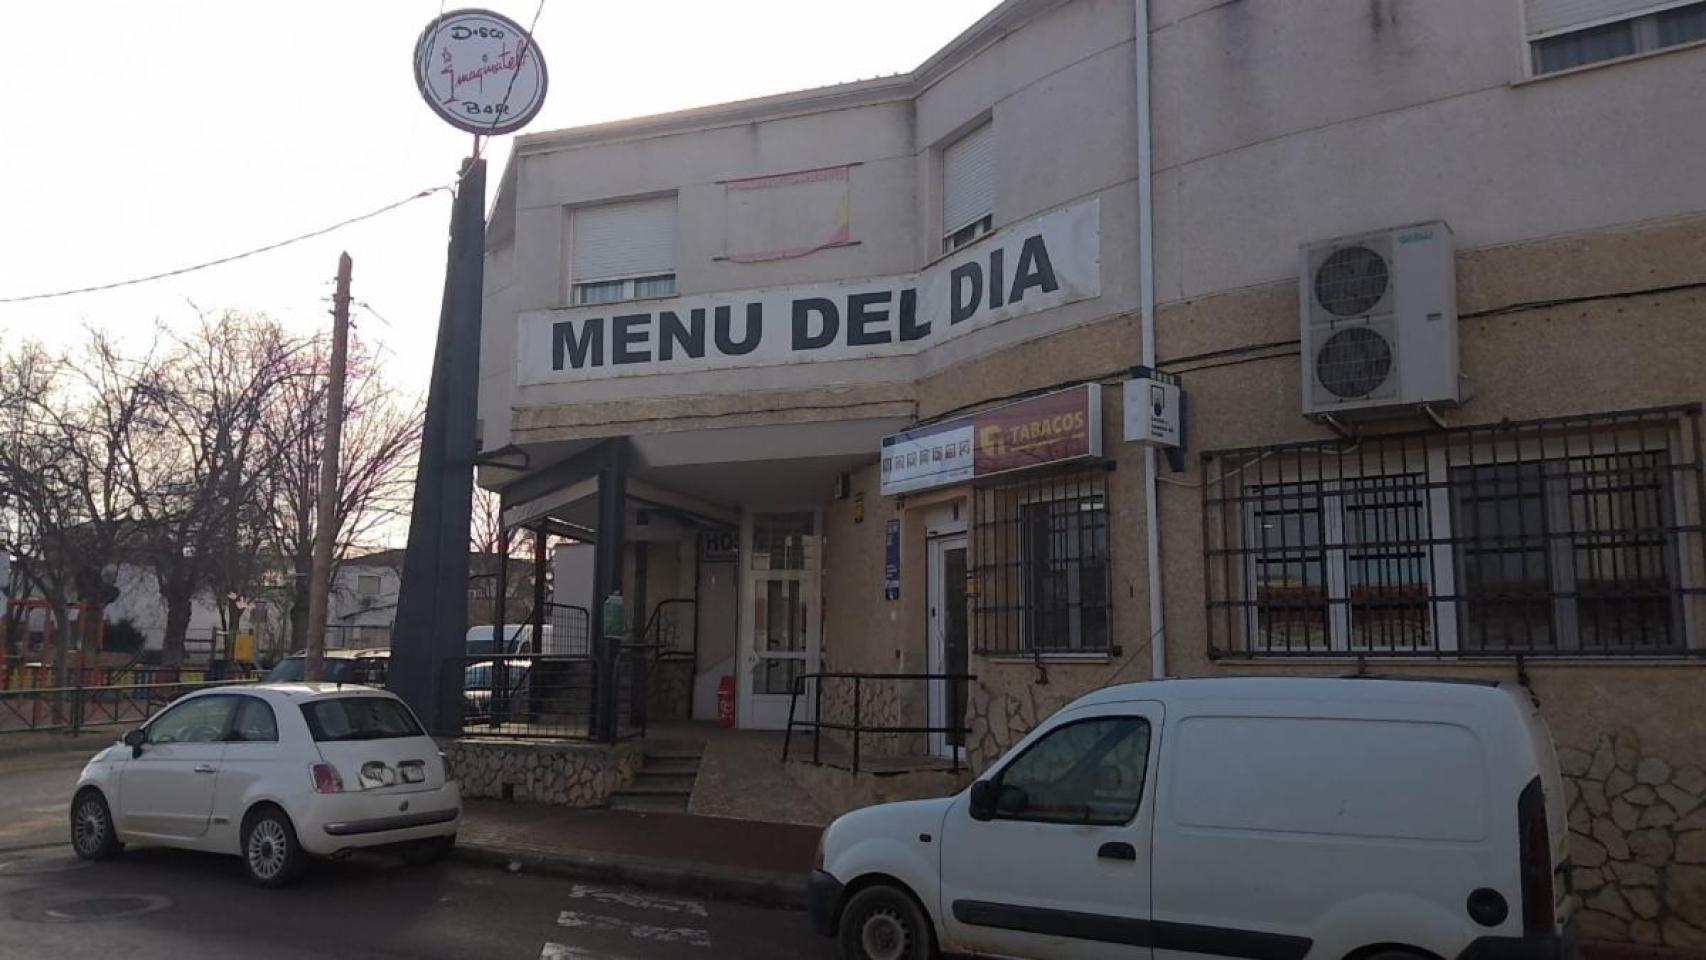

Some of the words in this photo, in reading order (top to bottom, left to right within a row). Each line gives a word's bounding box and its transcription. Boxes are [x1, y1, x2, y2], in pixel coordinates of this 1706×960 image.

[462, 101, 510, 115] BAR
[552, 302, 763, 371] MENU
[791, 288, 932, 351] DEL
[950, 234, 1060, 326] DIA
[1009, 410, 1084, 442] TABACOS
